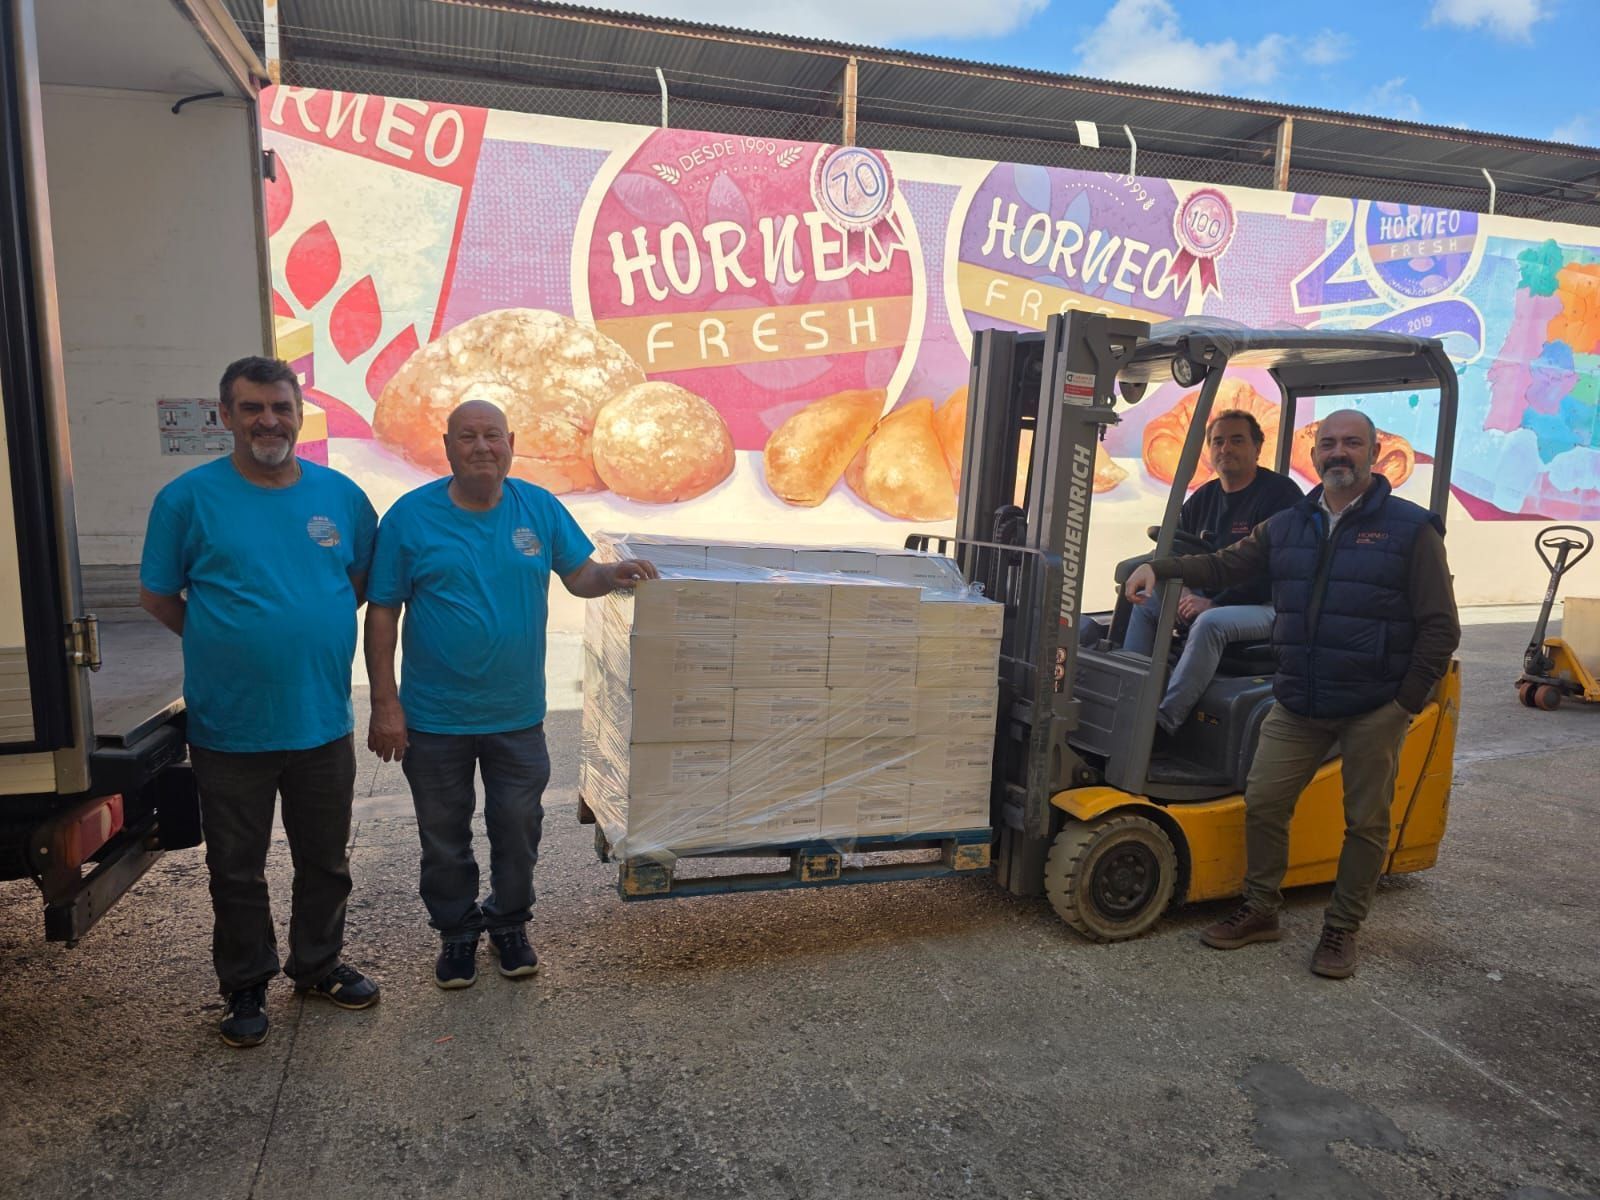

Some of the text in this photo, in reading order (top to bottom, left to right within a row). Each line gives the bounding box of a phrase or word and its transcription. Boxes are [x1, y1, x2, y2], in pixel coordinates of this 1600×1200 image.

[679, 138, 776, 171] DESDE 1999
[831, 163, 880, 205] 70
[1191, 211, 1220, 238] 100
[1380, 210, 1460, 240] HORNEO
[981, 197, 1174, 300] HORNEO
[1390, 238, 1457, 258] FRESH
[646, 306, 878, 364] FRESH
[1408, 315, 1433, 334] 2019
[1059, 443, 1091, 628] JUNGHEINRICH
